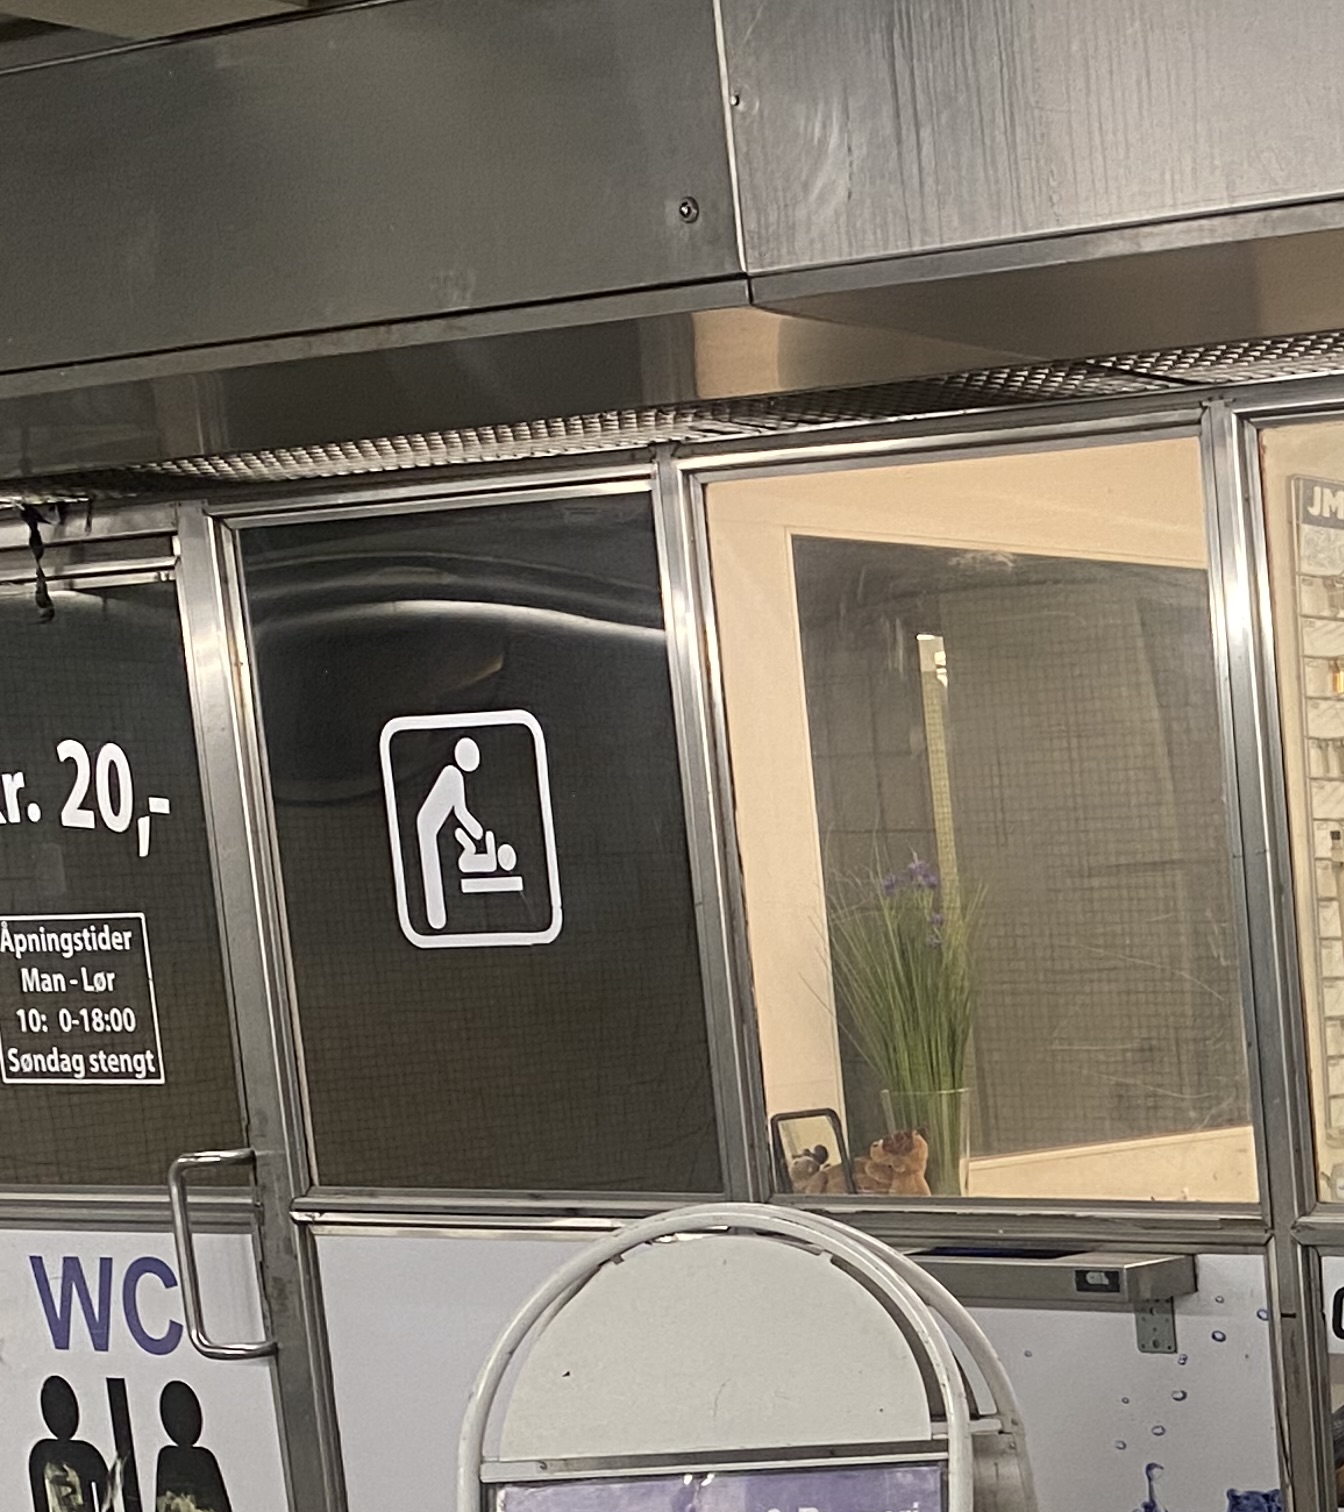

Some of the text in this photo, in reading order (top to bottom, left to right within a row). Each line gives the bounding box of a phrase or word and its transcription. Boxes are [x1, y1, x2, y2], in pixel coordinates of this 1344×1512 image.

[0, 739, 170, 857] r. 20,-
[0, 921, 132, 958] Åpningstider
[21, 968, 66, 992] Man
[81, 967, 115, 992] Lør
[8, 1047, 156, 1080] Søndag stengt
[29, 1256, 183, 1356] WC
